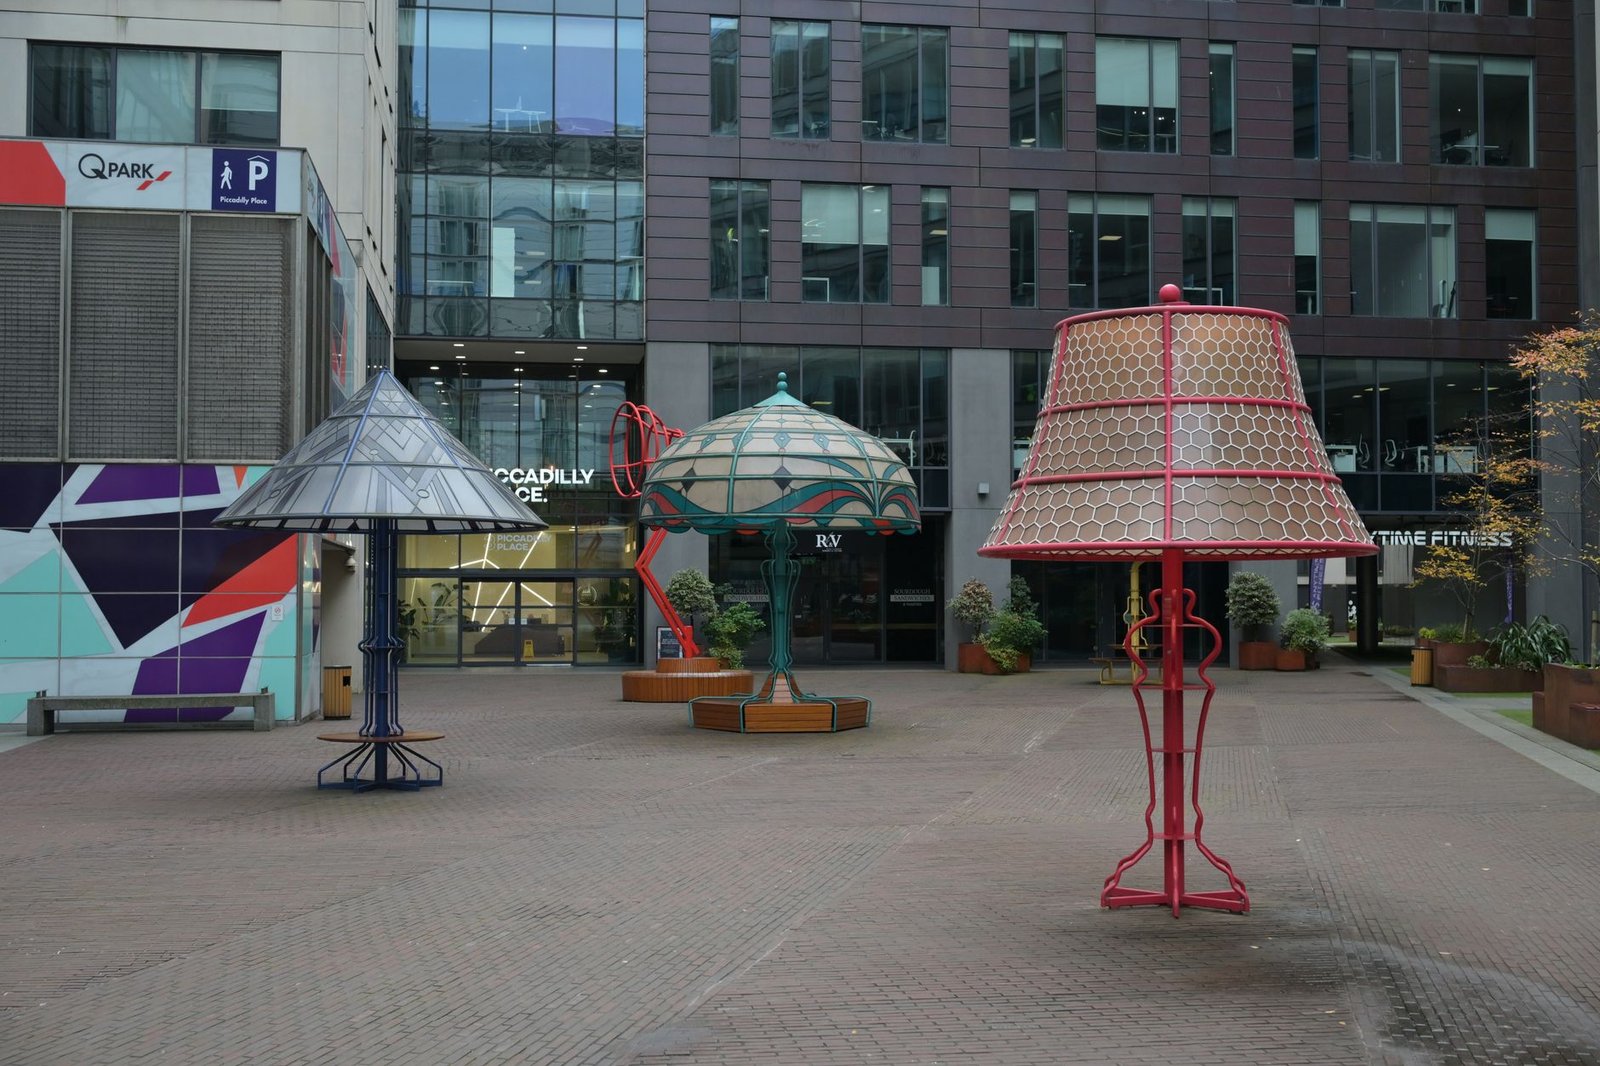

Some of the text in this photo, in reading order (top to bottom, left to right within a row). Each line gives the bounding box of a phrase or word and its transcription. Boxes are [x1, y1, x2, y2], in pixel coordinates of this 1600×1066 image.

[220, 196, 267, 205] Piccadilly Place
[489, 468, 595, 484] CCADILLY
[1430, 530, 1513, 547] FITNESS
